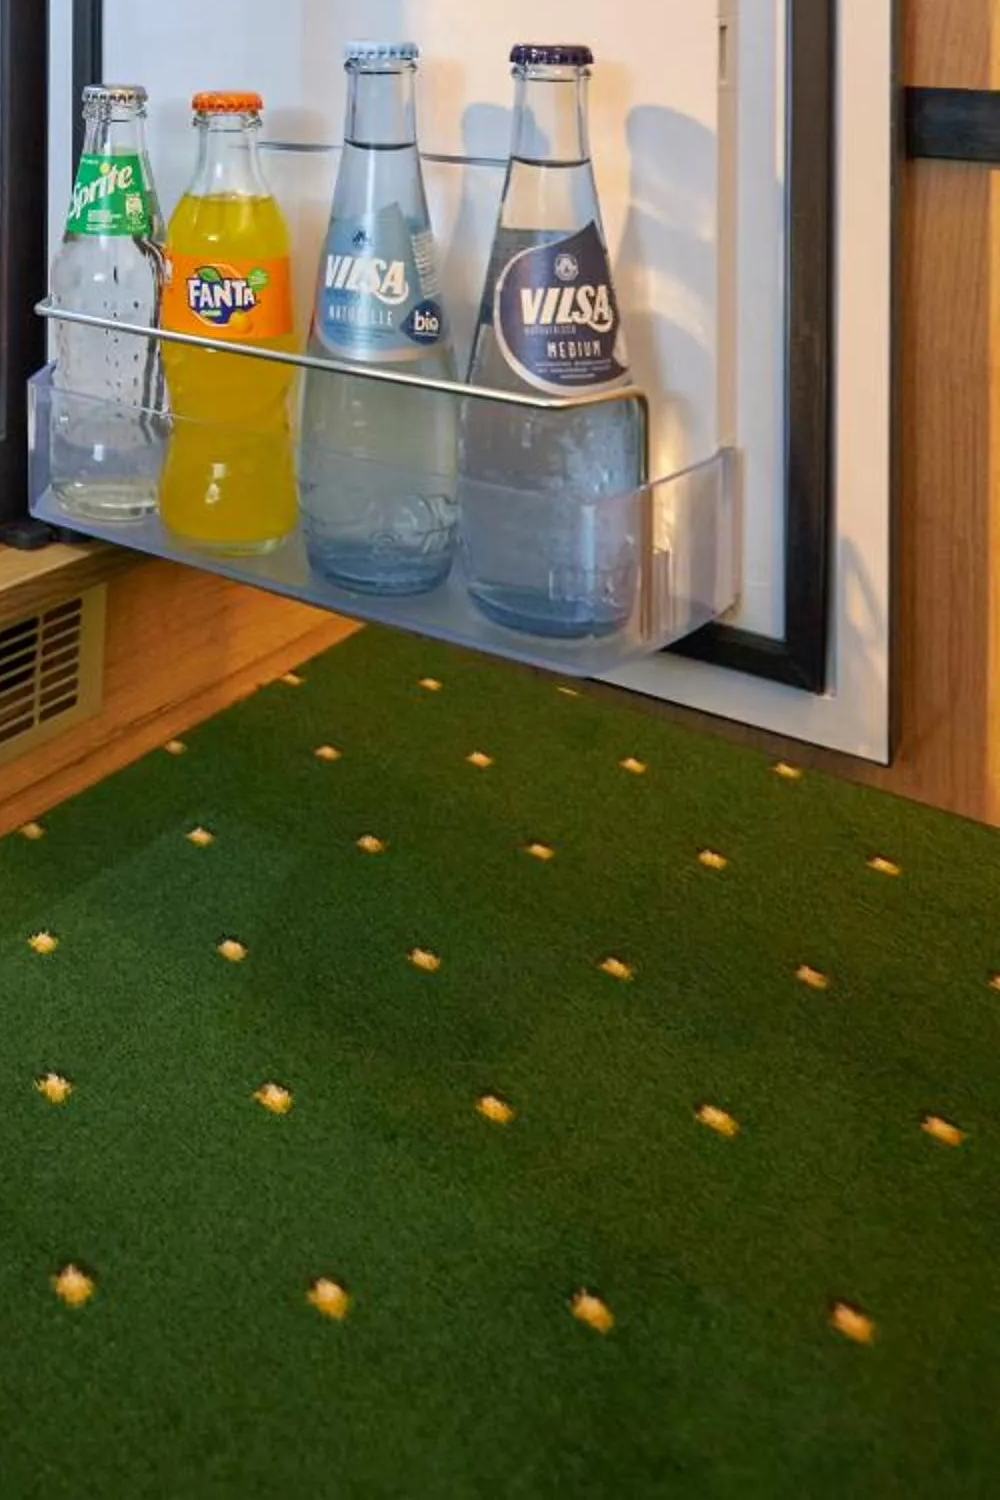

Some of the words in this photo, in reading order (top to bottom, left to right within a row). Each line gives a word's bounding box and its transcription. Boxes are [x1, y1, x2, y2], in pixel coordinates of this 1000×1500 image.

[67, 163, 133, 220] Sprite
[188, 279, 256, 309] FANTA
[325, 254, 409, 305] VILSA
[328, 303, 394, 327] NATULLE
[414, 310, 439, 332] bio
[520, 284, 614, 333] VILSA
[546, 340, 602, 359] MEDIUM
